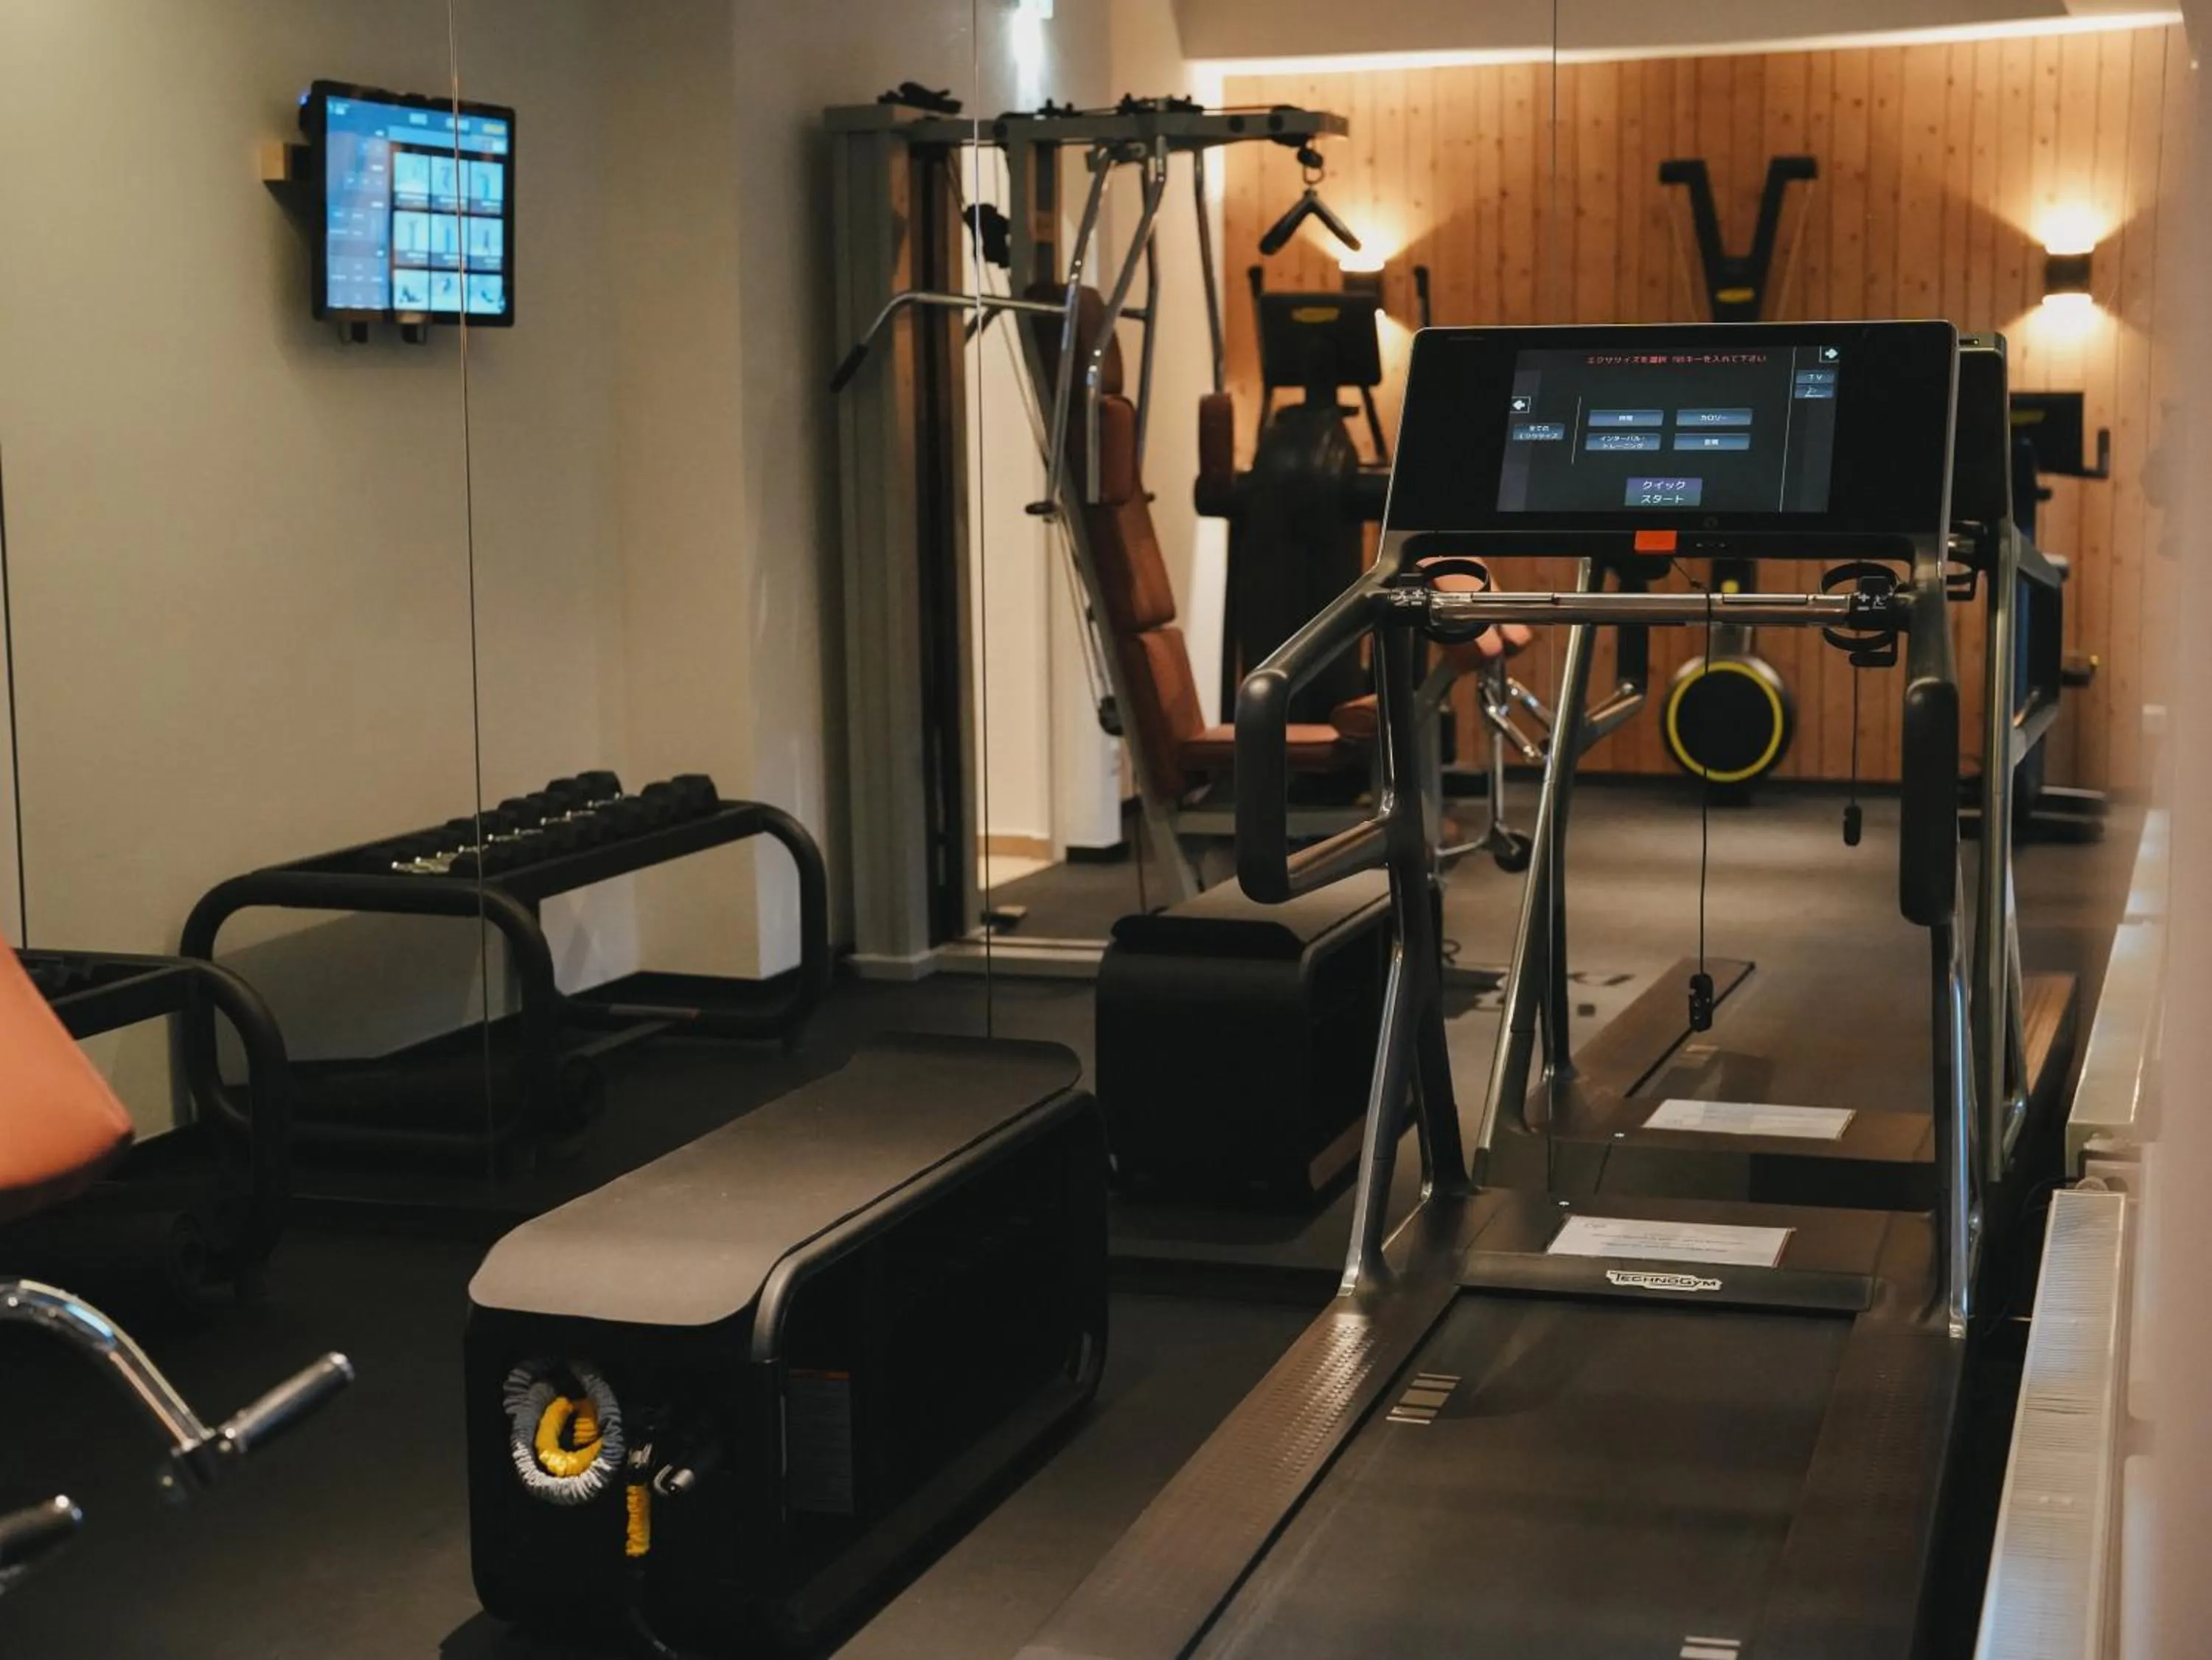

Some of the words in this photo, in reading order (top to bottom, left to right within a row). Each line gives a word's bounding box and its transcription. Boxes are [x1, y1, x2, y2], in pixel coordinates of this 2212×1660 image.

[1643, 481, 1686, 490] クイック
[1641, 495, 1684, 503] スタート
